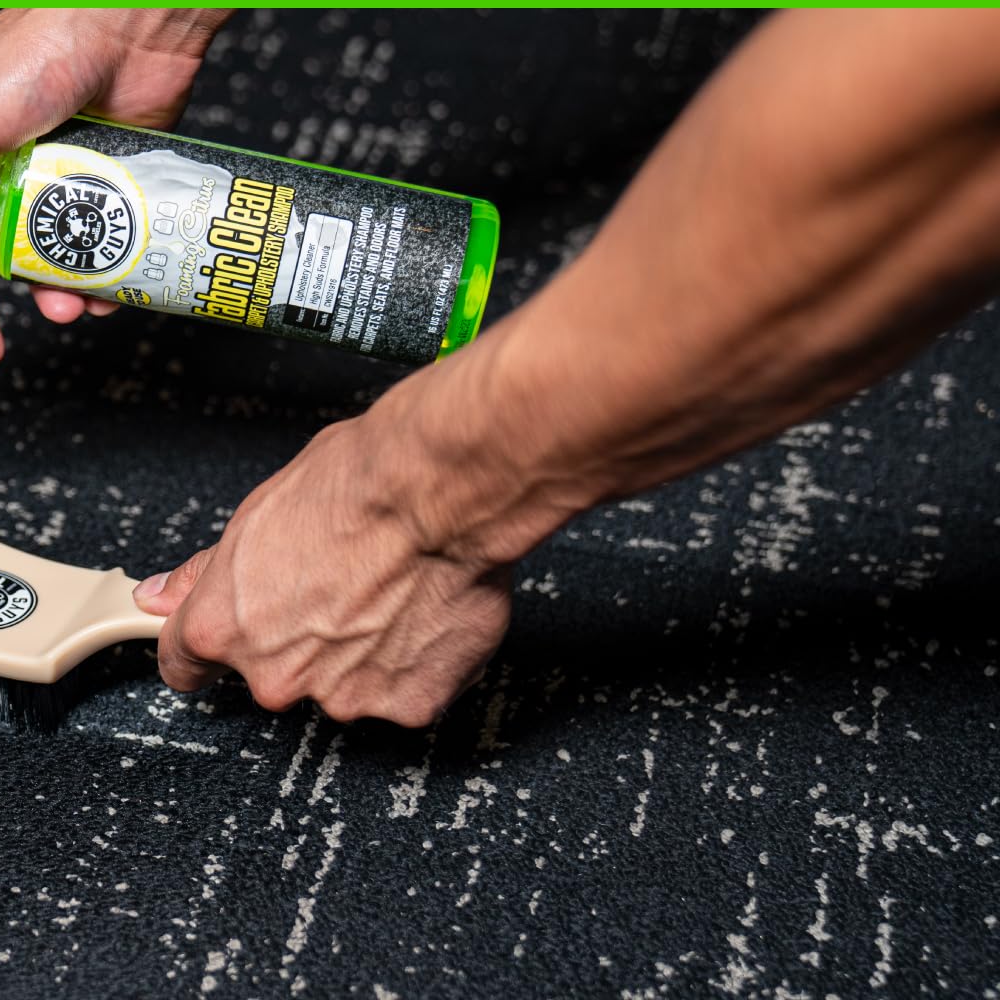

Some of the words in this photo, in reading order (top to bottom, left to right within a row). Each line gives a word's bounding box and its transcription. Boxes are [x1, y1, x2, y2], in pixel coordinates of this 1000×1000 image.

[36, 183, 90, 266] CHEMICAL
[178, 176, 216, 243] Citrus
[207, 175, 275, 256] Clean
[267, 184, 297, 236] SHAMPOO
[391, 206, 406, 231] MATS
[99, 207, 127, 261] GUYS
[354, 206, 374, 249] SHAMPOO
[369, 222, 387, 252] ODORS
[302, 242, 316, 268] Cleaner
[318, 244, 331, 273] Formula
[384, 230, 402, 259] FLOOR
[163, 241, 206, 307] Foaming
[252, 233, 286, 298] UPHOLSTERY
[338, 247, 364, 307] UPHOLSTERY
[365, 252, 380, 274] AND
[380, 257, 396, 280] AND
[191, 252, 258, 325] Fabric
[295, 268, 310, 302] Upholstery
[314, 273, 325, 289] Suds
[356, 273, 376, 307] STAINS
[310, 288, 322, 305] High
[372, 282, 392, 312] SEATS,
[434, 296, 446, 306] OZ
[335, 307, 350, 324] AND
[347, 307, 367, 340] REMOVES
[429, 316, 440, 326] US
[432, 308, 443, 316] FL
